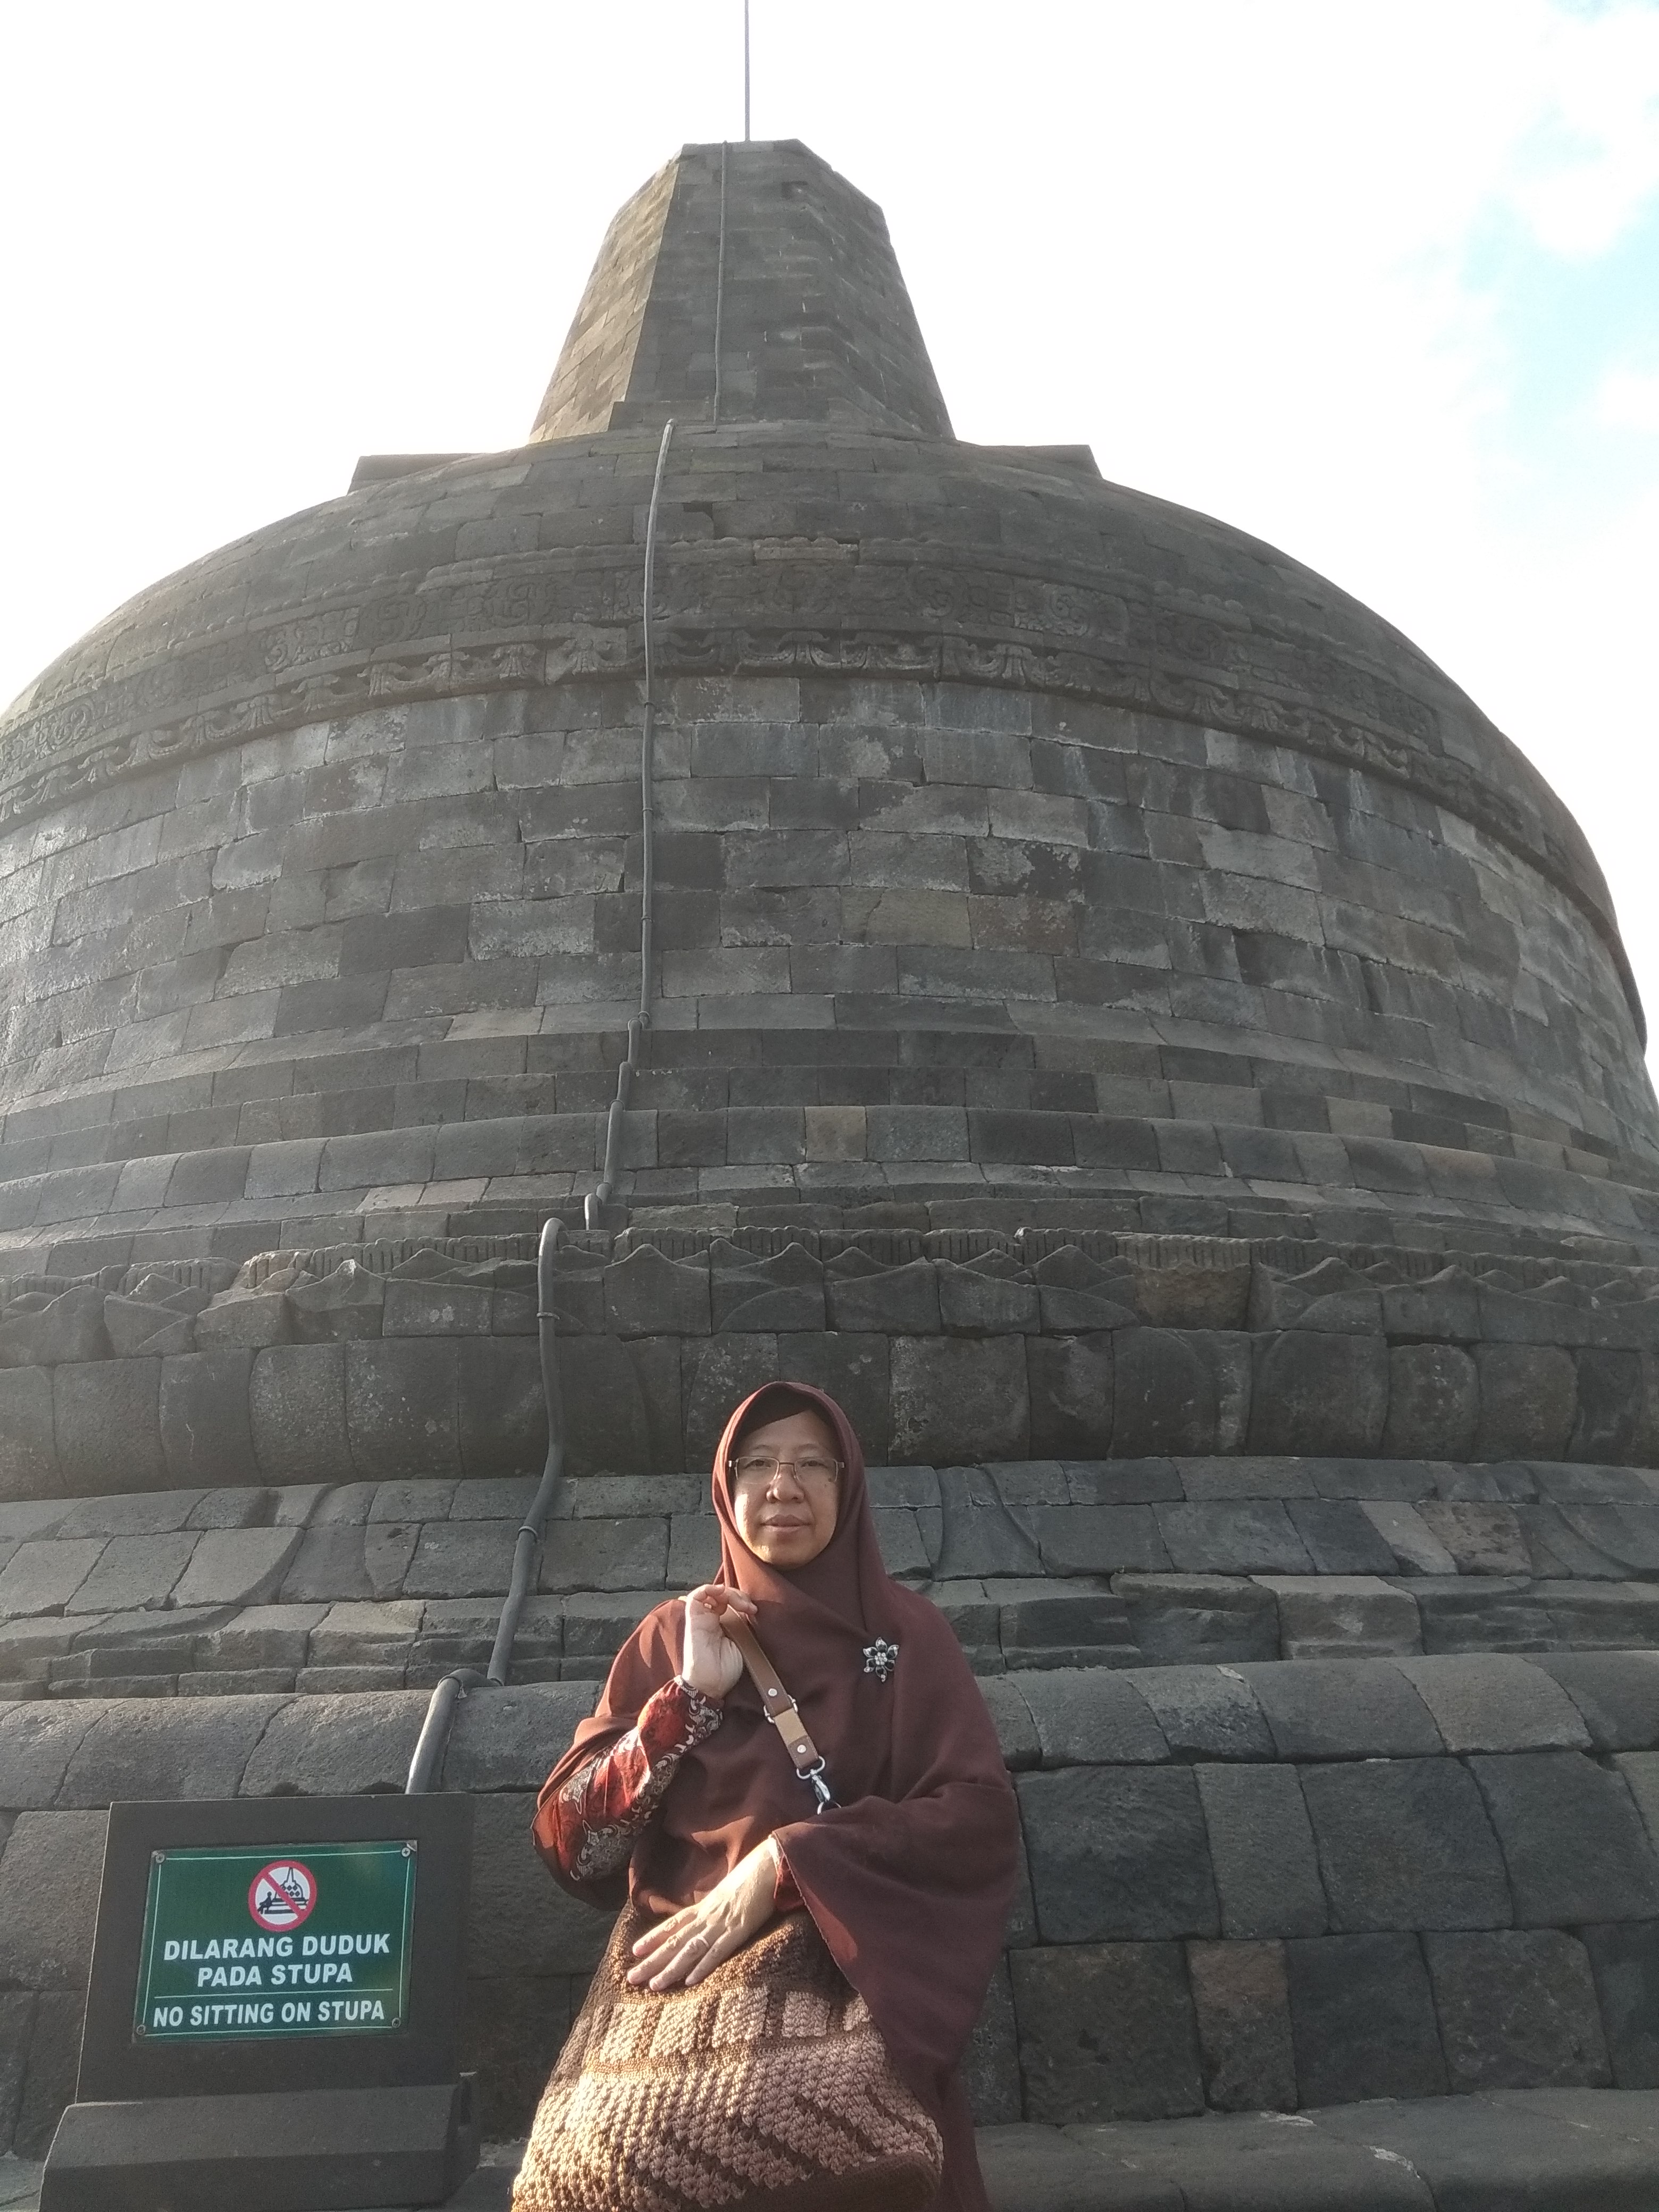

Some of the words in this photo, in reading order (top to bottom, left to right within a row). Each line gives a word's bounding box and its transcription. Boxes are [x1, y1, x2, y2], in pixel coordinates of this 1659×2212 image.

[164, 1937, 293, 1960] DILARANG
[302, 1933, 390, 1956] DUDUK
[197, 1966, 262, 1987] PADA
[271, 1963, 353, 1985] STUPA
[153, 2006, 183, 2027] NO
[190, 2003, 274, 2026] SITTING
[281, 2002, 311, 2023] ON
[318, 2000, 384, 2021] STUPA
